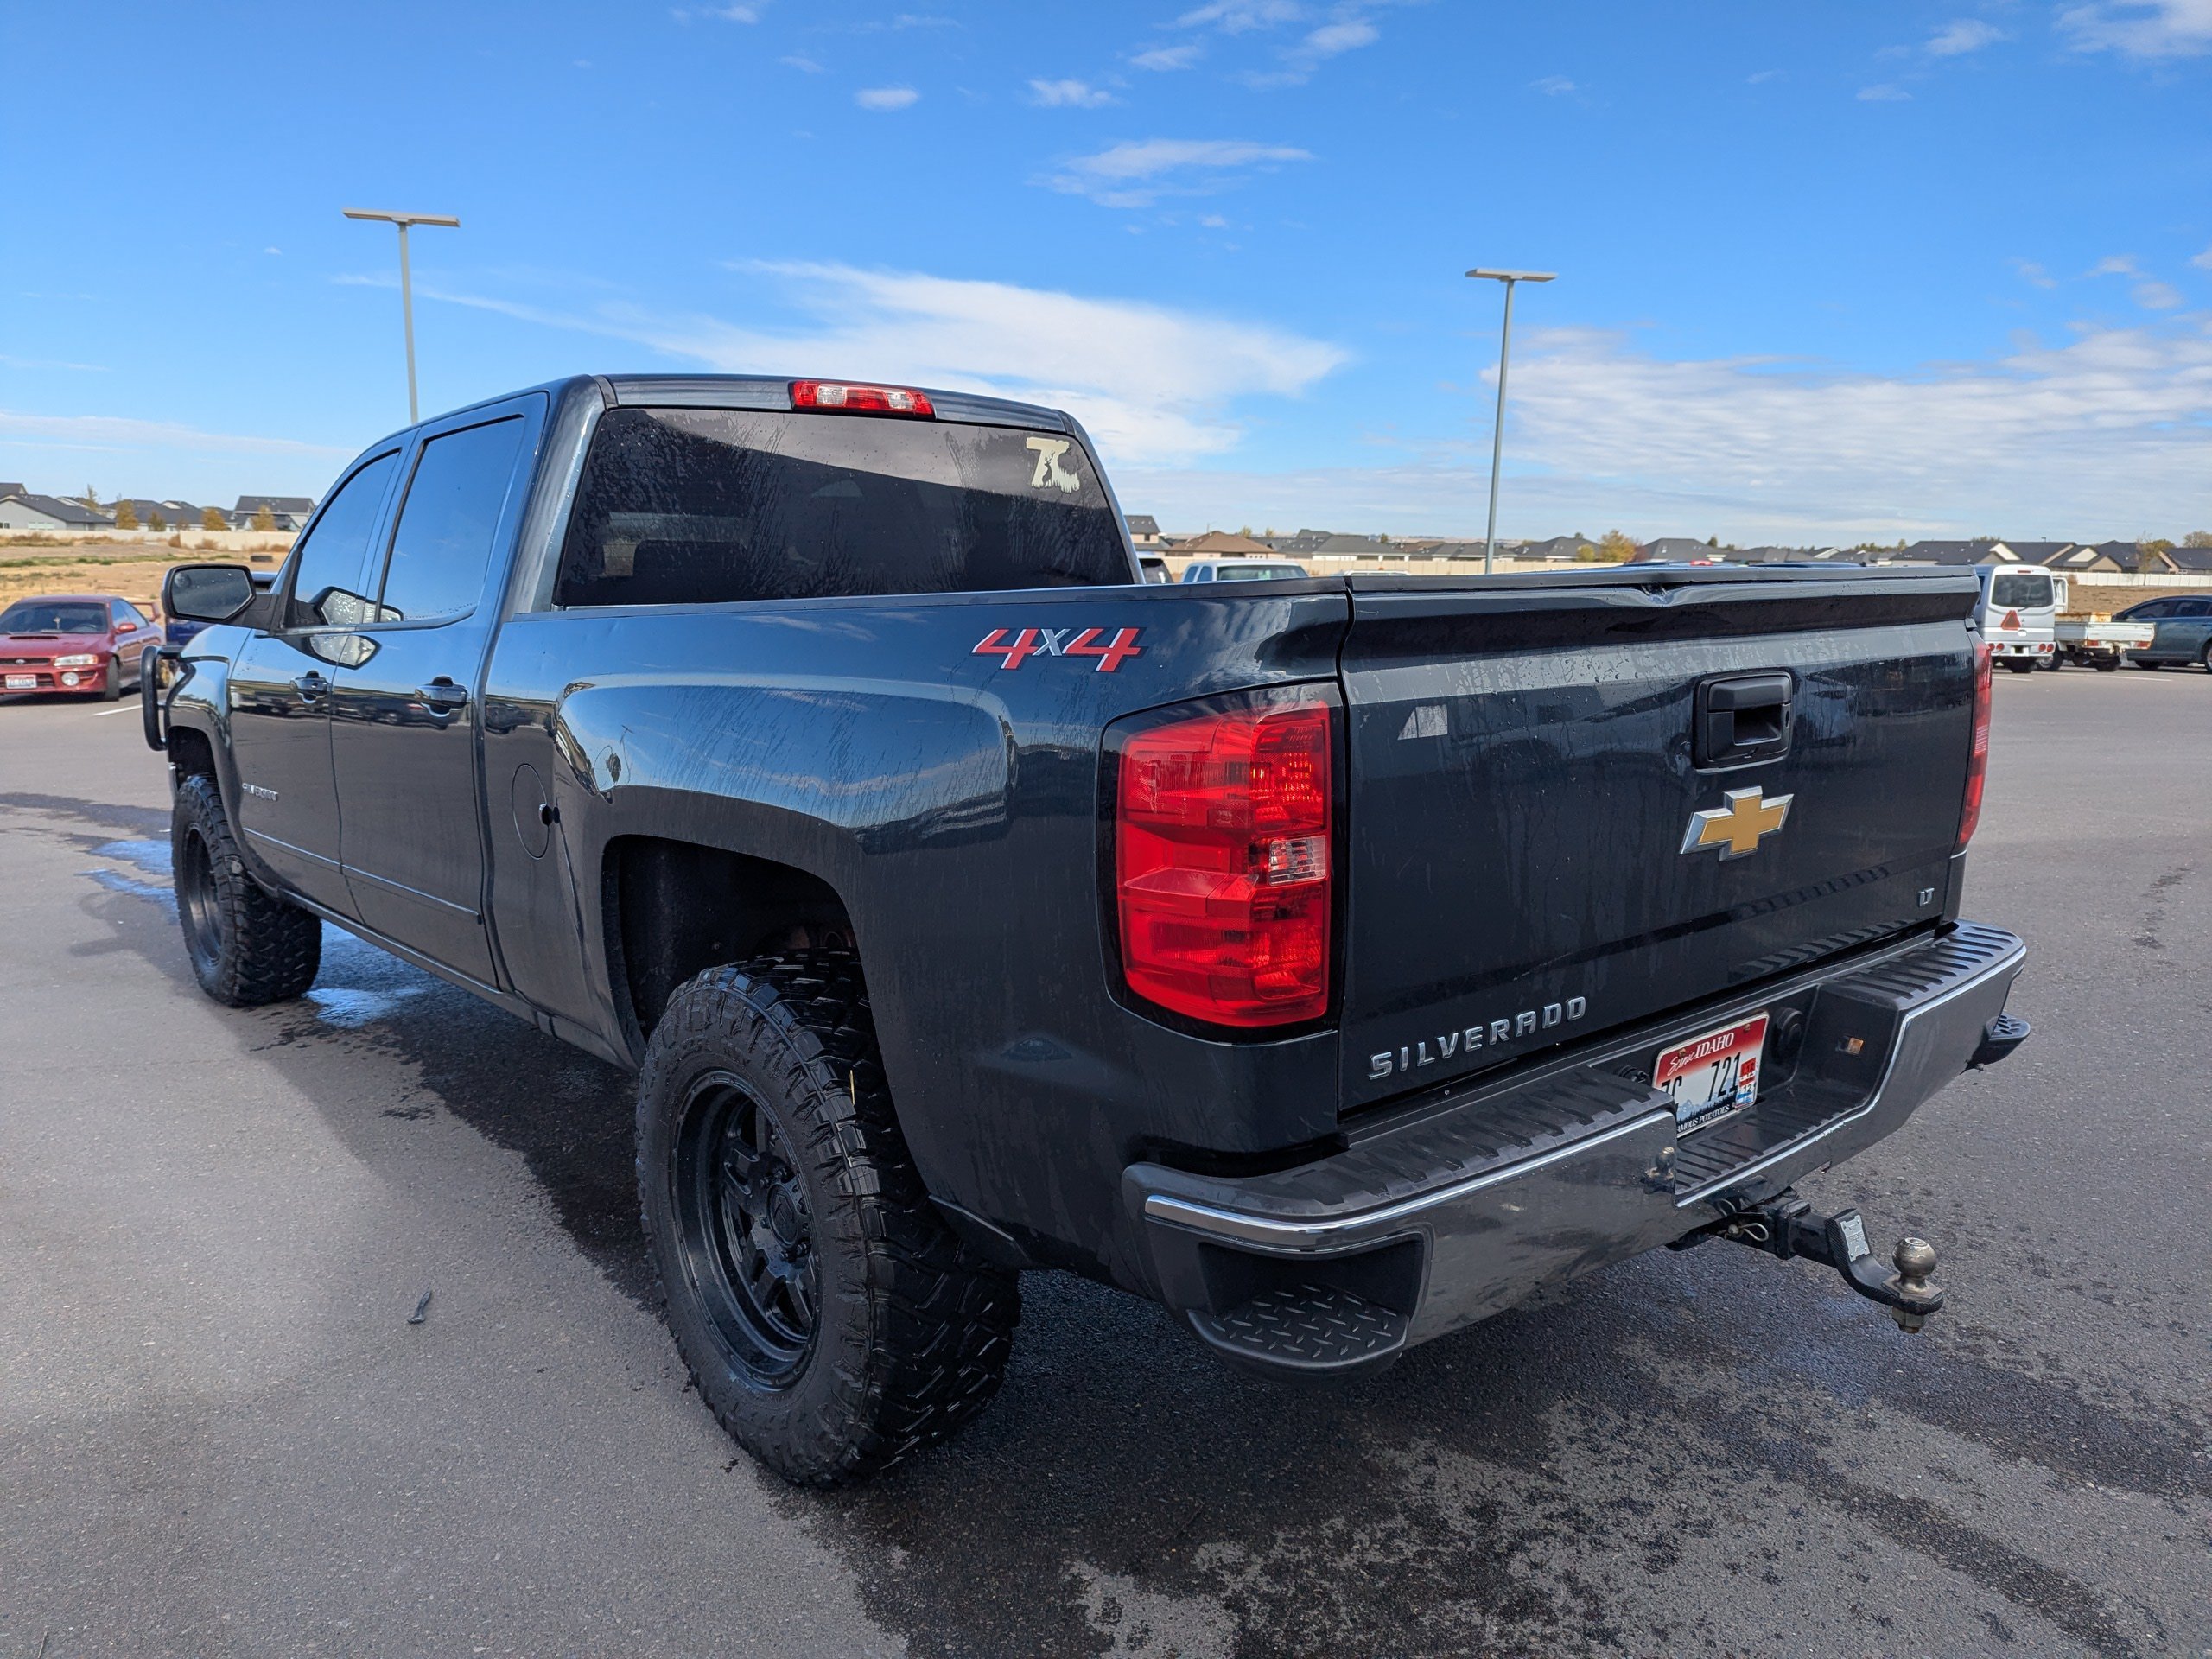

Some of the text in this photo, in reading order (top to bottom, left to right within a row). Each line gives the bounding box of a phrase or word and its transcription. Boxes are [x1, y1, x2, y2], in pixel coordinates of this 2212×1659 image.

[1918, 887, 1935, 907] LT
[1369, 996, 1586, 1080] SILVERADO
[1695, 1032, 1734, 1058] IDAHO
[1708, 1052, 1741, 1103] 721
[1677, 1117, 1699, 1133] AMOUS
